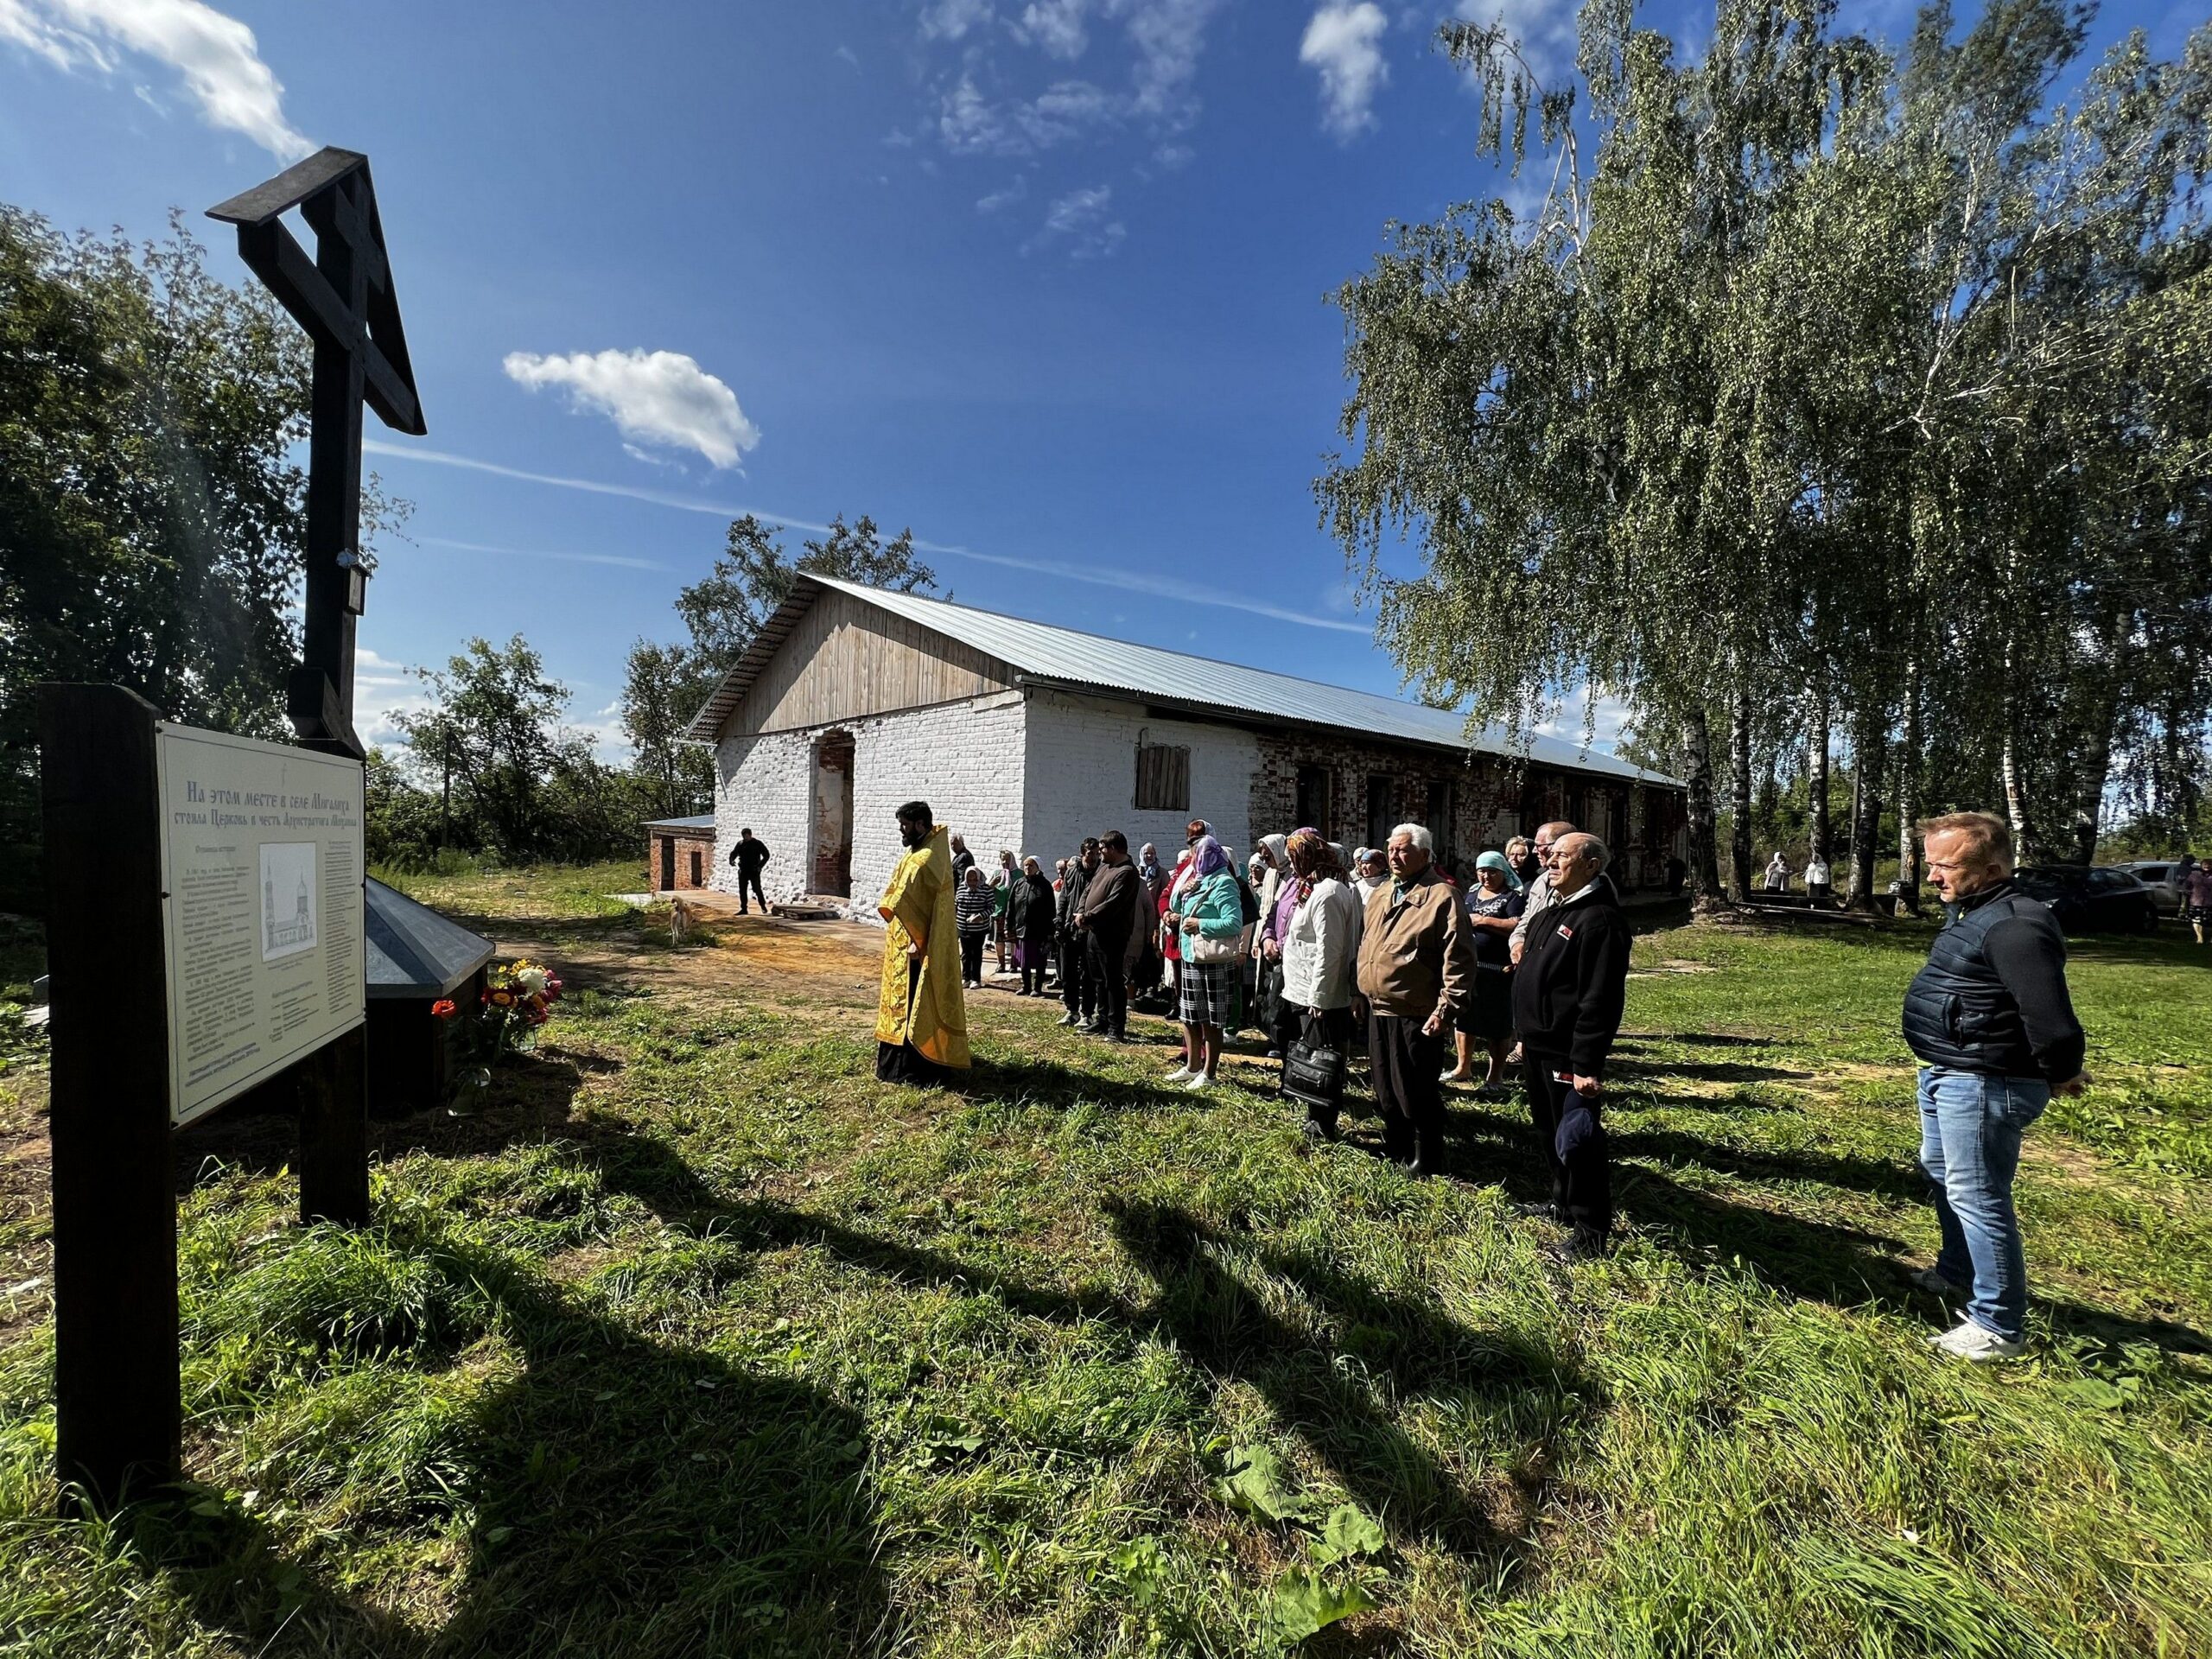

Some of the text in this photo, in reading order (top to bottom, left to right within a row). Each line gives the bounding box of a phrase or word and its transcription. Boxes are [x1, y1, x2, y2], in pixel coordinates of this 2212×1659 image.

[187, 780, 205, 803] На
[211, 789, 240, 804] этом
[245, 791, 277, 808] месте
[281, 795, 286, 808] в
[290, 796, 309, 810] селе
[175, 811, 207, 825] стояла
[211, 809, 247, 829] Церковь
[259, 815, 281, 826] честь
